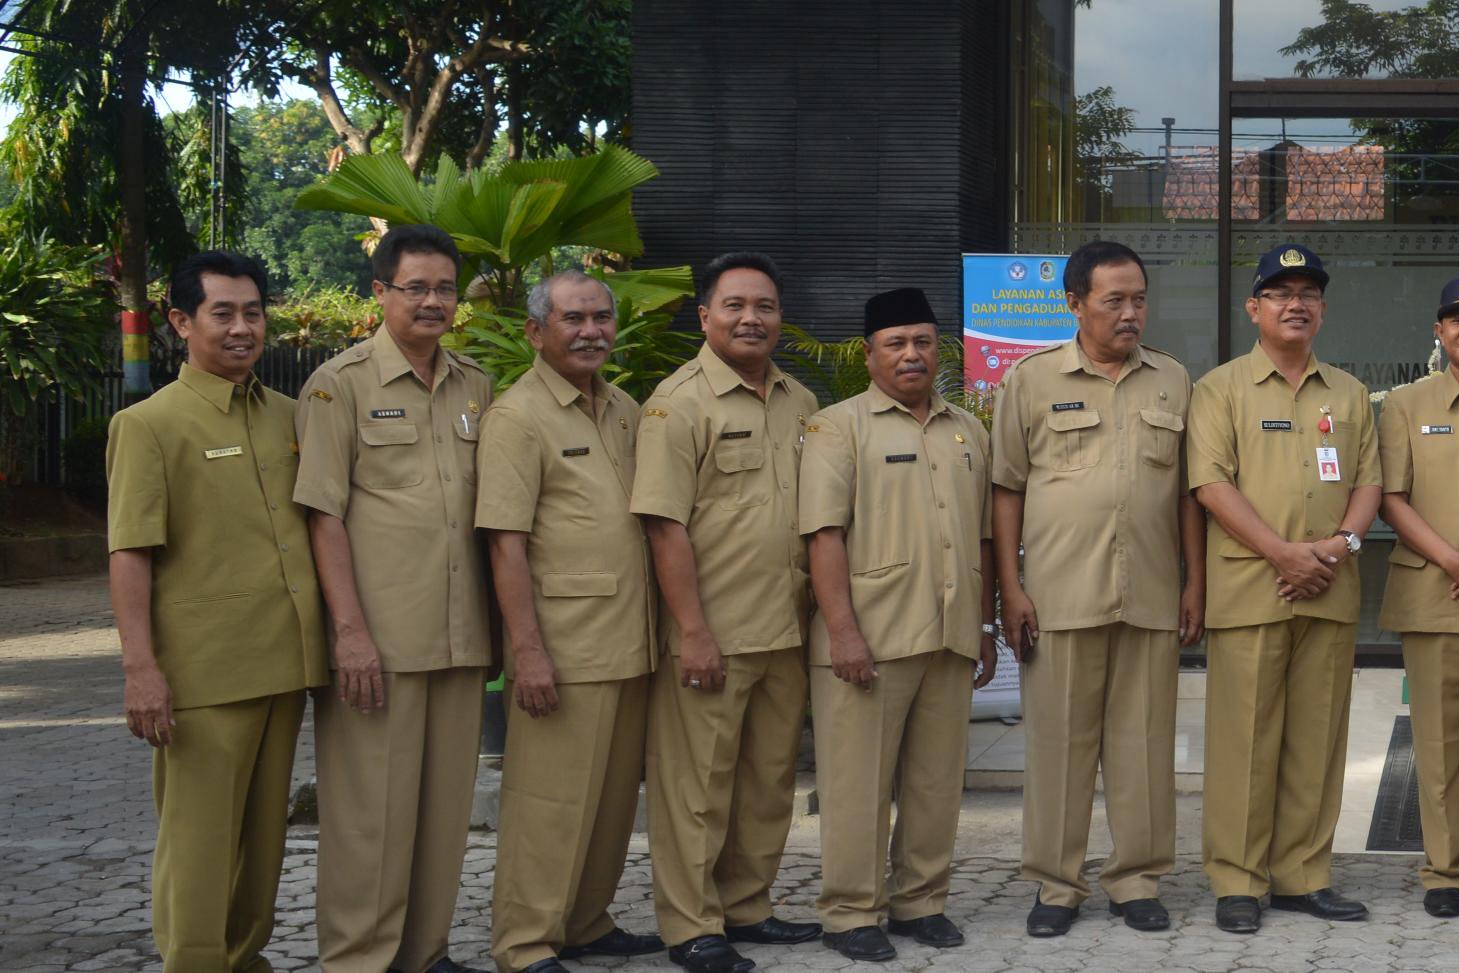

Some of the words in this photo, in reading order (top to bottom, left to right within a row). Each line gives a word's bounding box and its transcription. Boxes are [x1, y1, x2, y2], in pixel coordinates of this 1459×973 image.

[992, 289, 1045, 299] LAYANAN
[972, 303, 997, 314] DAN
[972, 319, 992, 328] DINAS
[1328, 362, 1430, 384] LAYANA
